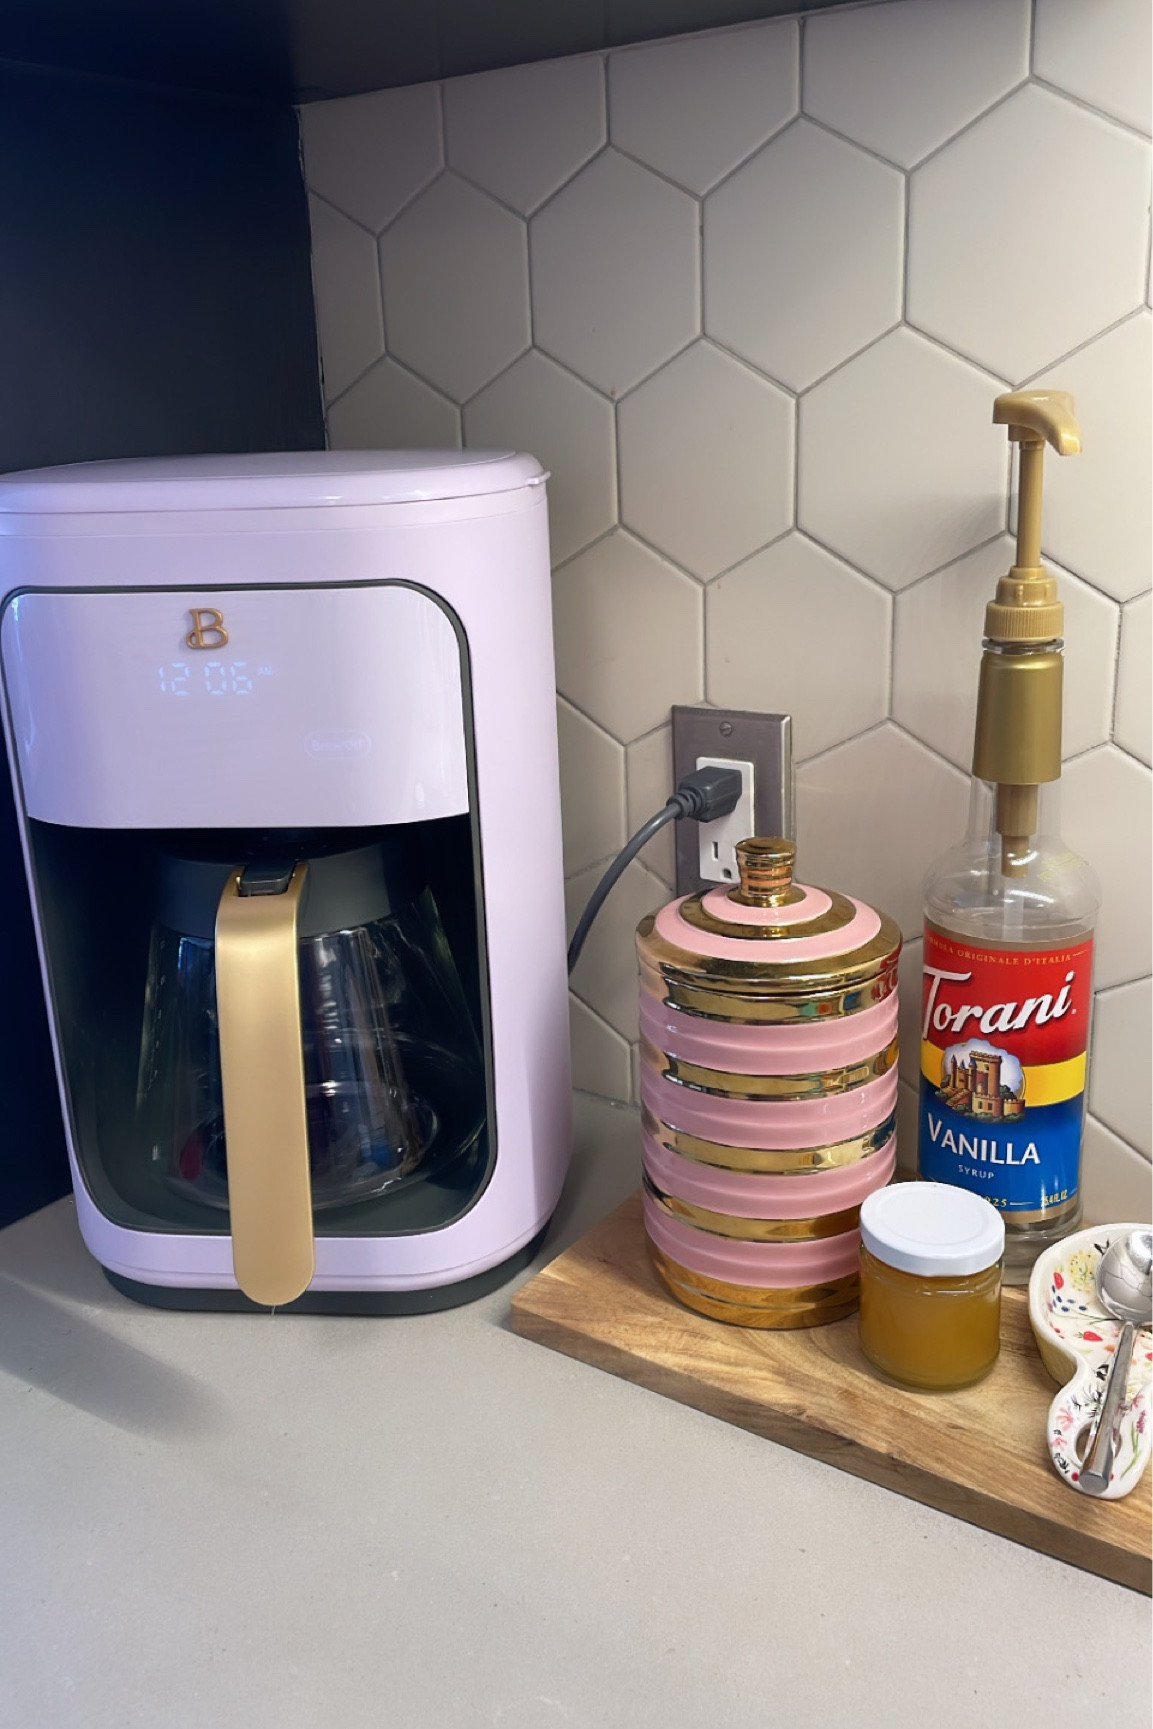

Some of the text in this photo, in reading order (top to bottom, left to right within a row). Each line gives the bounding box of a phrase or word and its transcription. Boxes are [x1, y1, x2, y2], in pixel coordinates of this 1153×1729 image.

[185, 607, 229, 650] B
[957, 949, 1019, 966] ORIGINALE
[1023, 954, 1072, 966] D'ITALIA
[922, 964, 1076, 1040] Torani
[927, 1112, 1041, 1166] VANILLA
[958, 1164, 995, 1180] SYRUP
